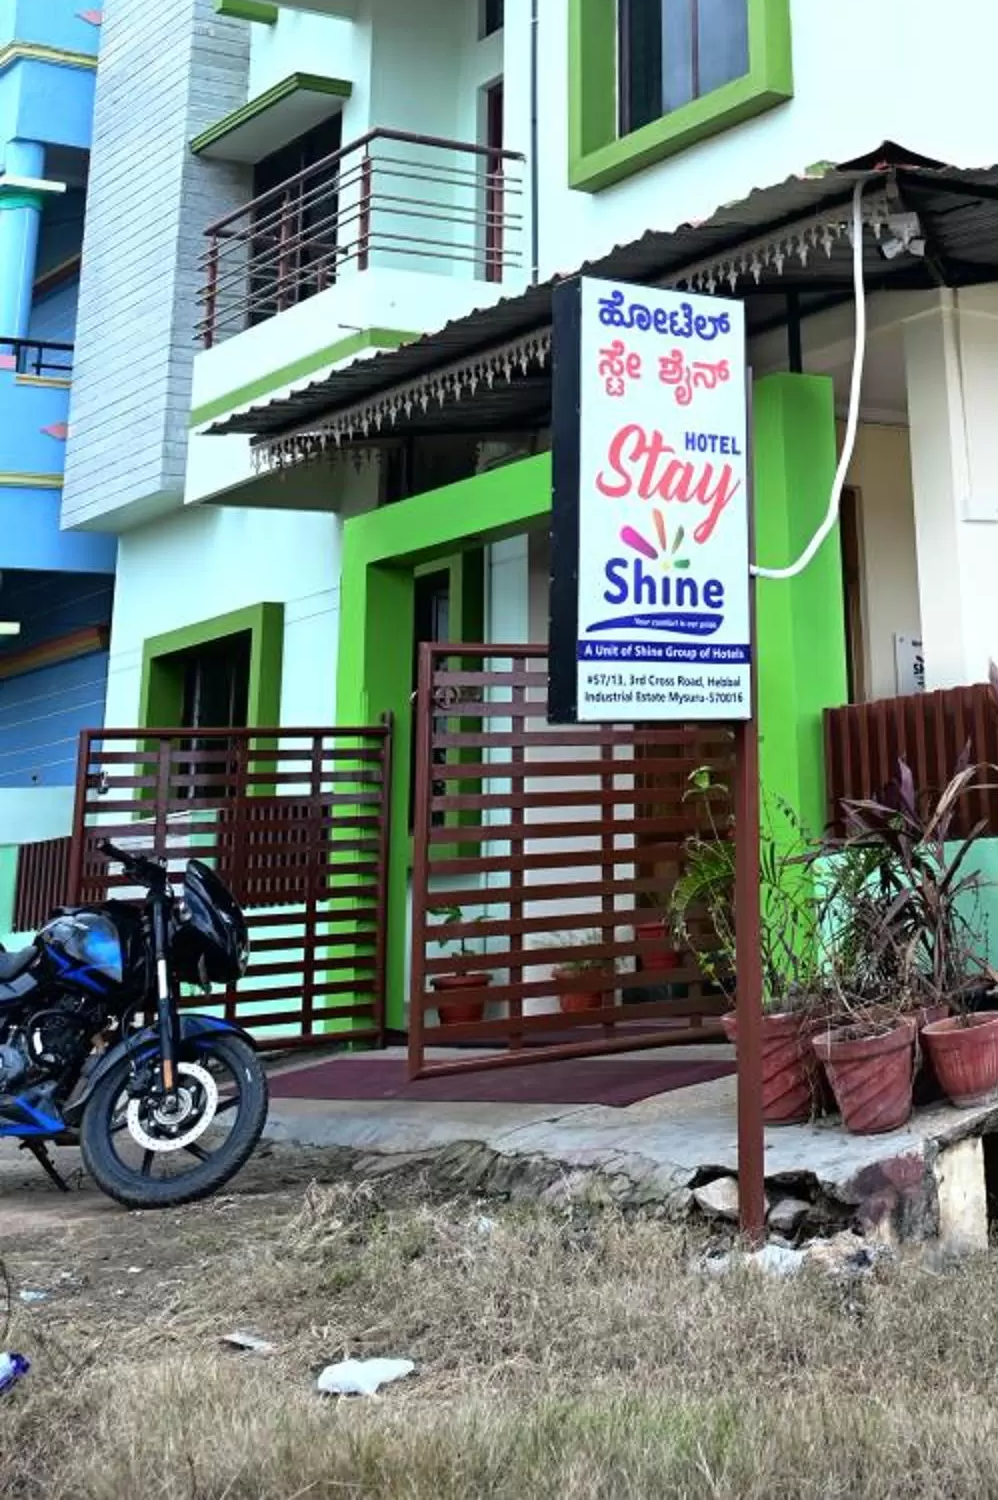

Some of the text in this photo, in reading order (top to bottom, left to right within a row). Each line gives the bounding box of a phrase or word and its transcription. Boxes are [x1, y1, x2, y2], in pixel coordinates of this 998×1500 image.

[598, 290, 731, 340] ಹೋಟೆಲ್
[598, 339, 641, 396] ಸ್ಟೇ
[685, 431, 741, 455] HOTEL
[595, 424, 741, 544] Stay
[603, 557, 725, 609] Shine
[584, 644, 745, 660] A Unit of Shine Group of Hotels
[584, 691, 633, 702] Industrial
[635, 691, 666, 703] Estate
[629, 674, 646, 686] 3rd
[648, 674, 675, 687] Cross
[677, 675, 705, 688] Road,
[707, 675, 741, 687] Hebbal
